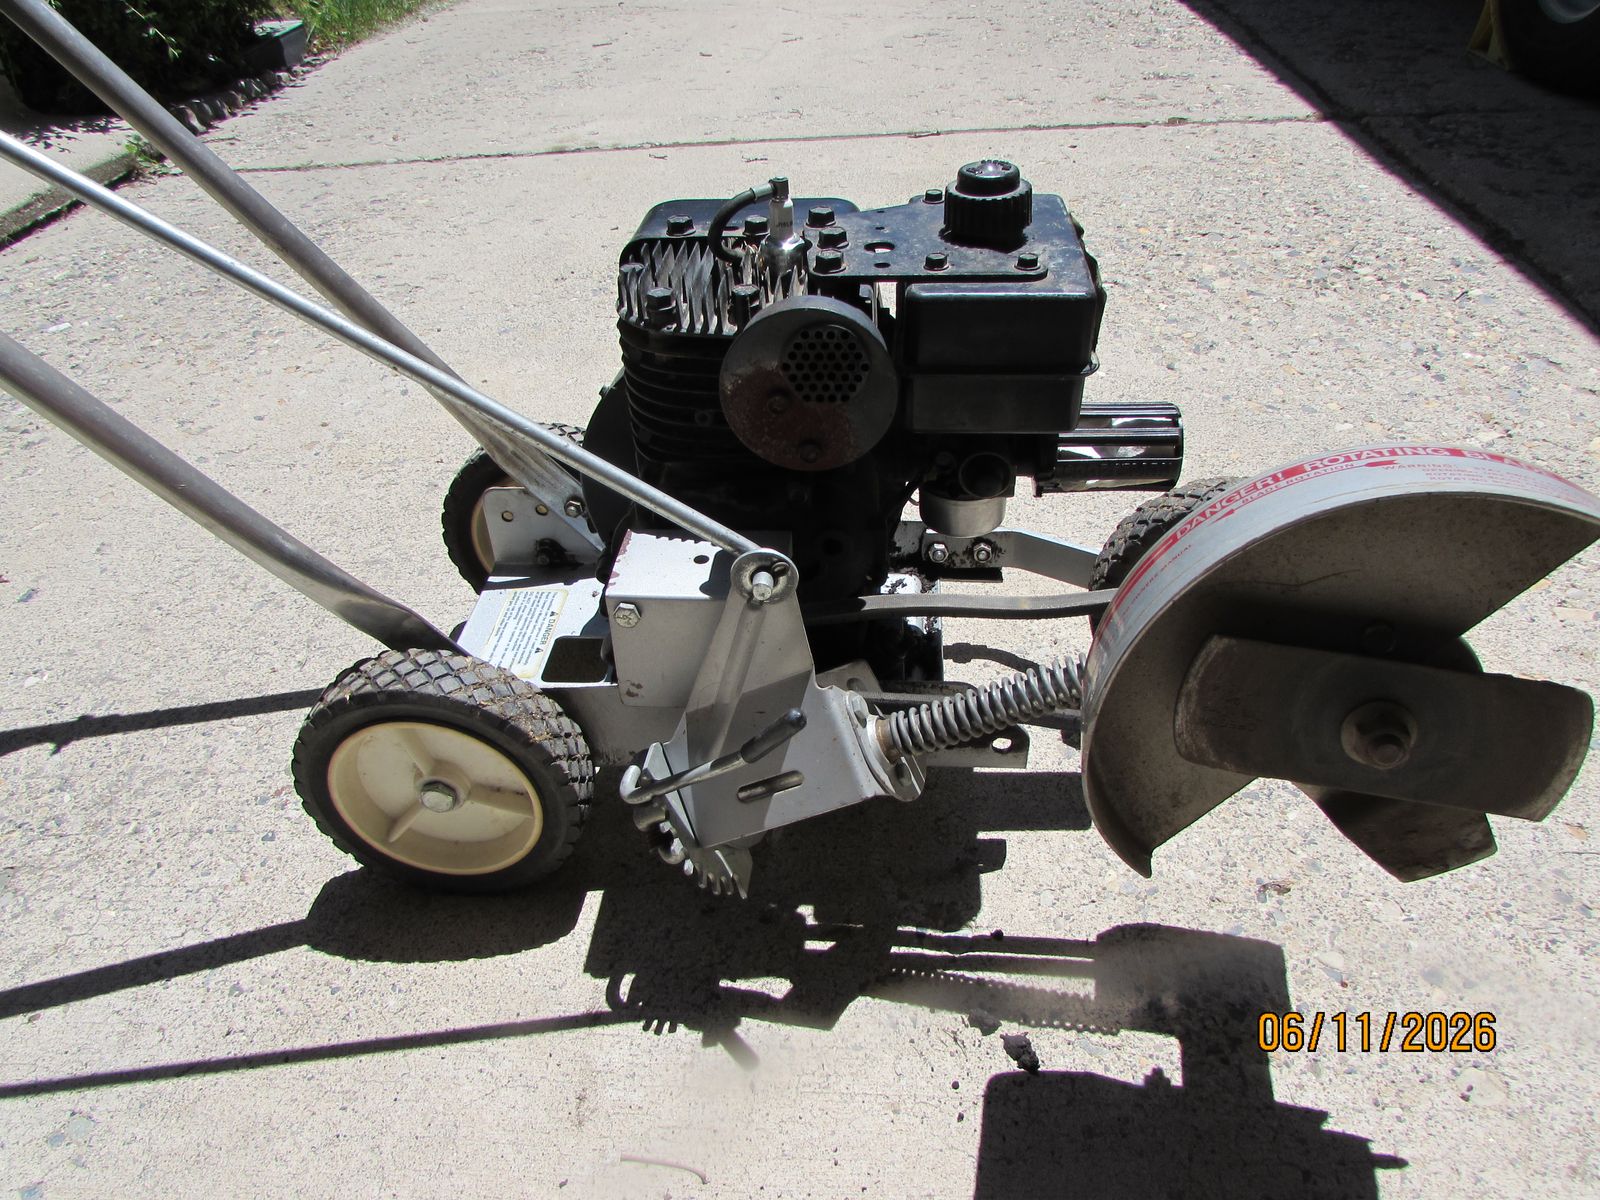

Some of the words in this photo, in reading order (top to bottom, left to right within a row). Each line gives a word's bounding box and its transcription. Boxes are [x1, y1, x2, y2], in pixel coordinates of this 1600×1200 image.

[1286, 463, 1354, 484] ROTATION
[1175, 472, 1284, 540] DANGER!
[1303, 447, 1451, 472] ROTATING
[540, 618, 554, 646] DANGER
